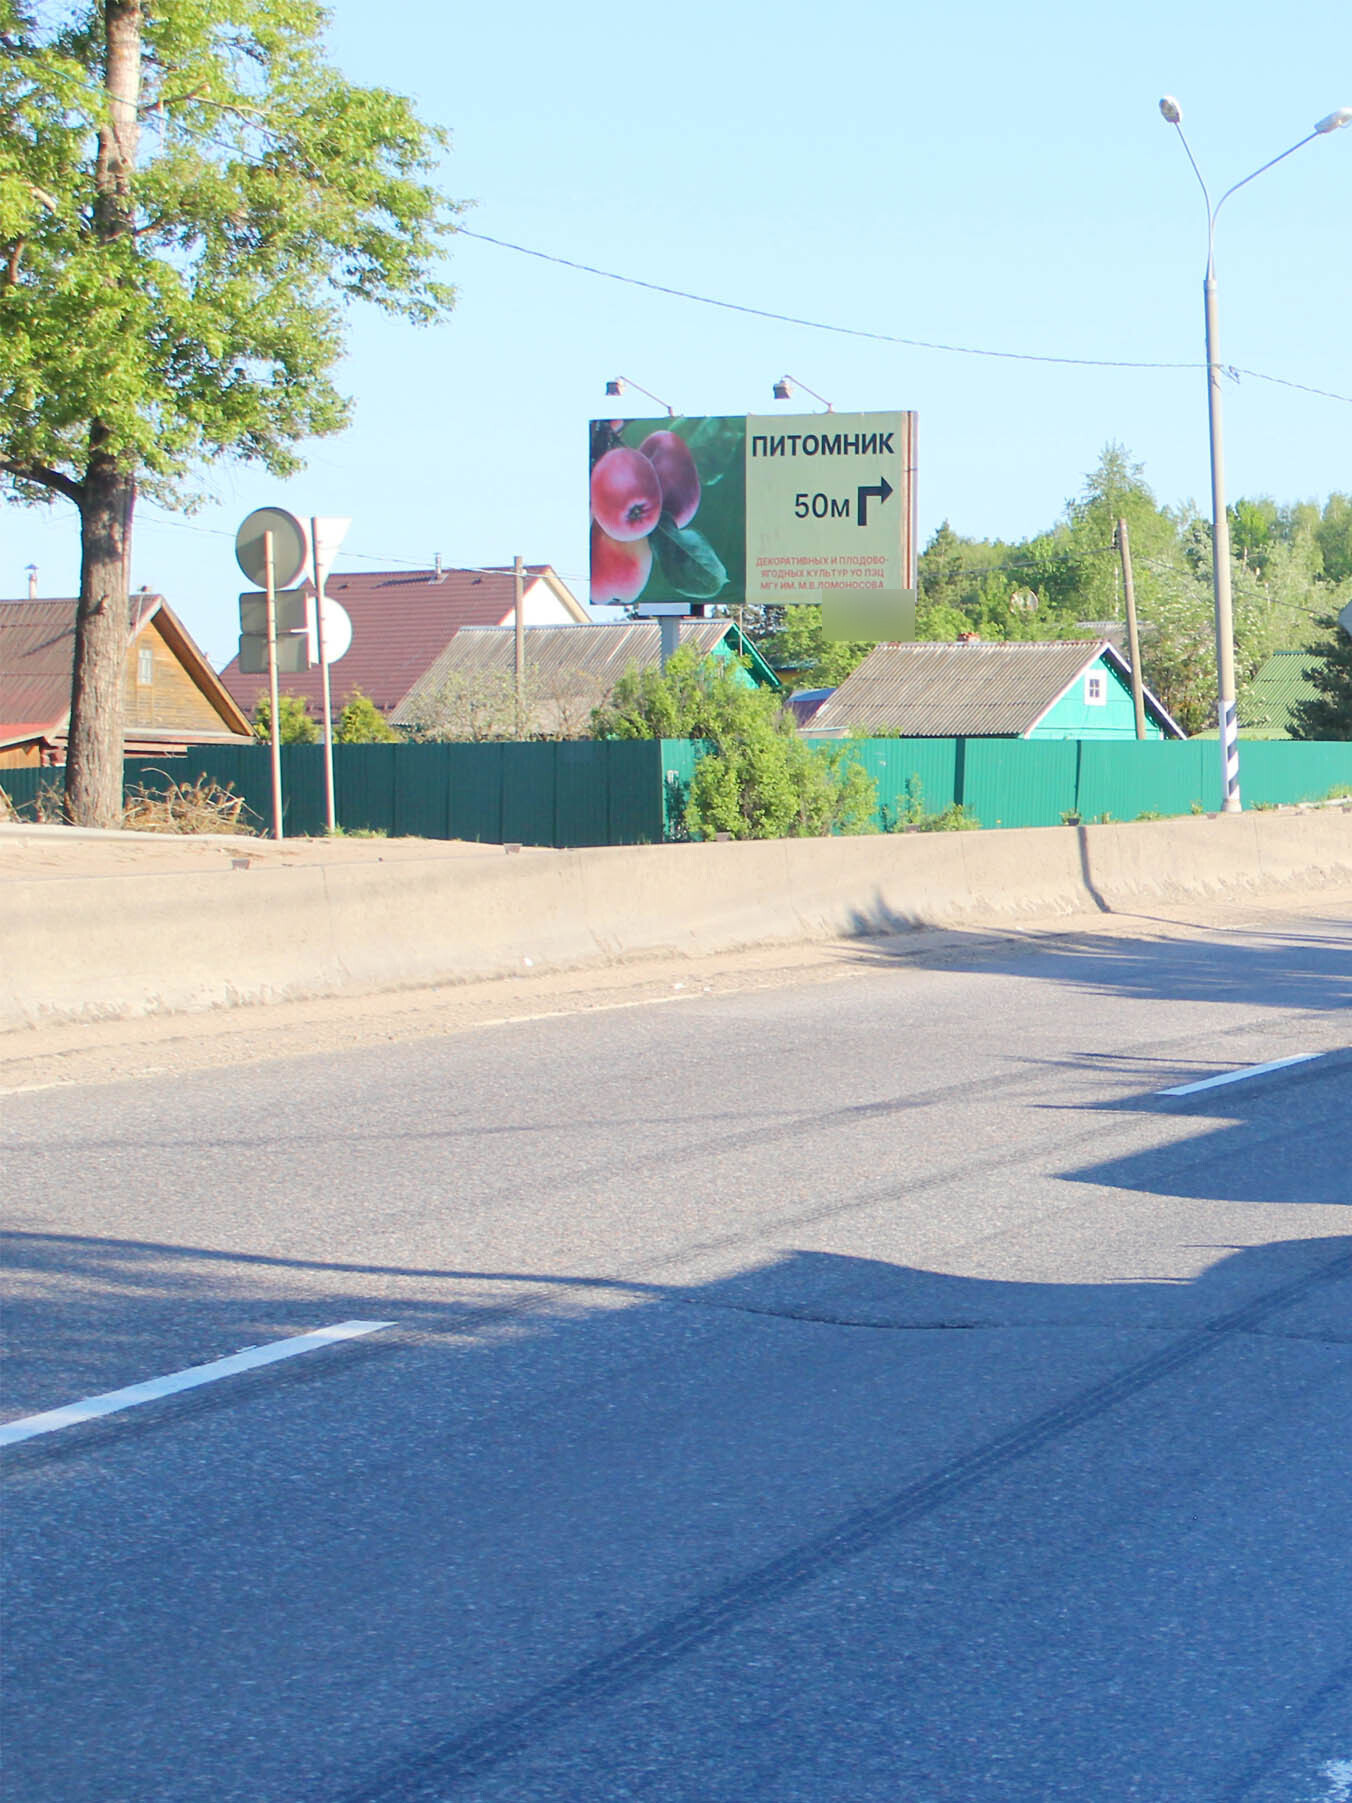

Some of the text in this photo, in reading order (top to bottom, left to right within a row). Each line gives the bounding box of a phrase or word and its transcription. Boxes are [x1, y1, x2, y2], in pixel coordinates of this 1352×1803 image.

[751, 432, 895, 457] ПИТОМНИК
[794, 493, 851, 519] 50м
[756, 556, 829, 568] ДЕКОРАТИВНЫХ
[831, 556, 838, 566] И
[761, 569, 804, 579] ЯГОДНЫХ
[806, 568, 848, 578] КУЛЬТУР
[851, 568, 863, 578] УО
[760, 581, 779, 591] МГУ
